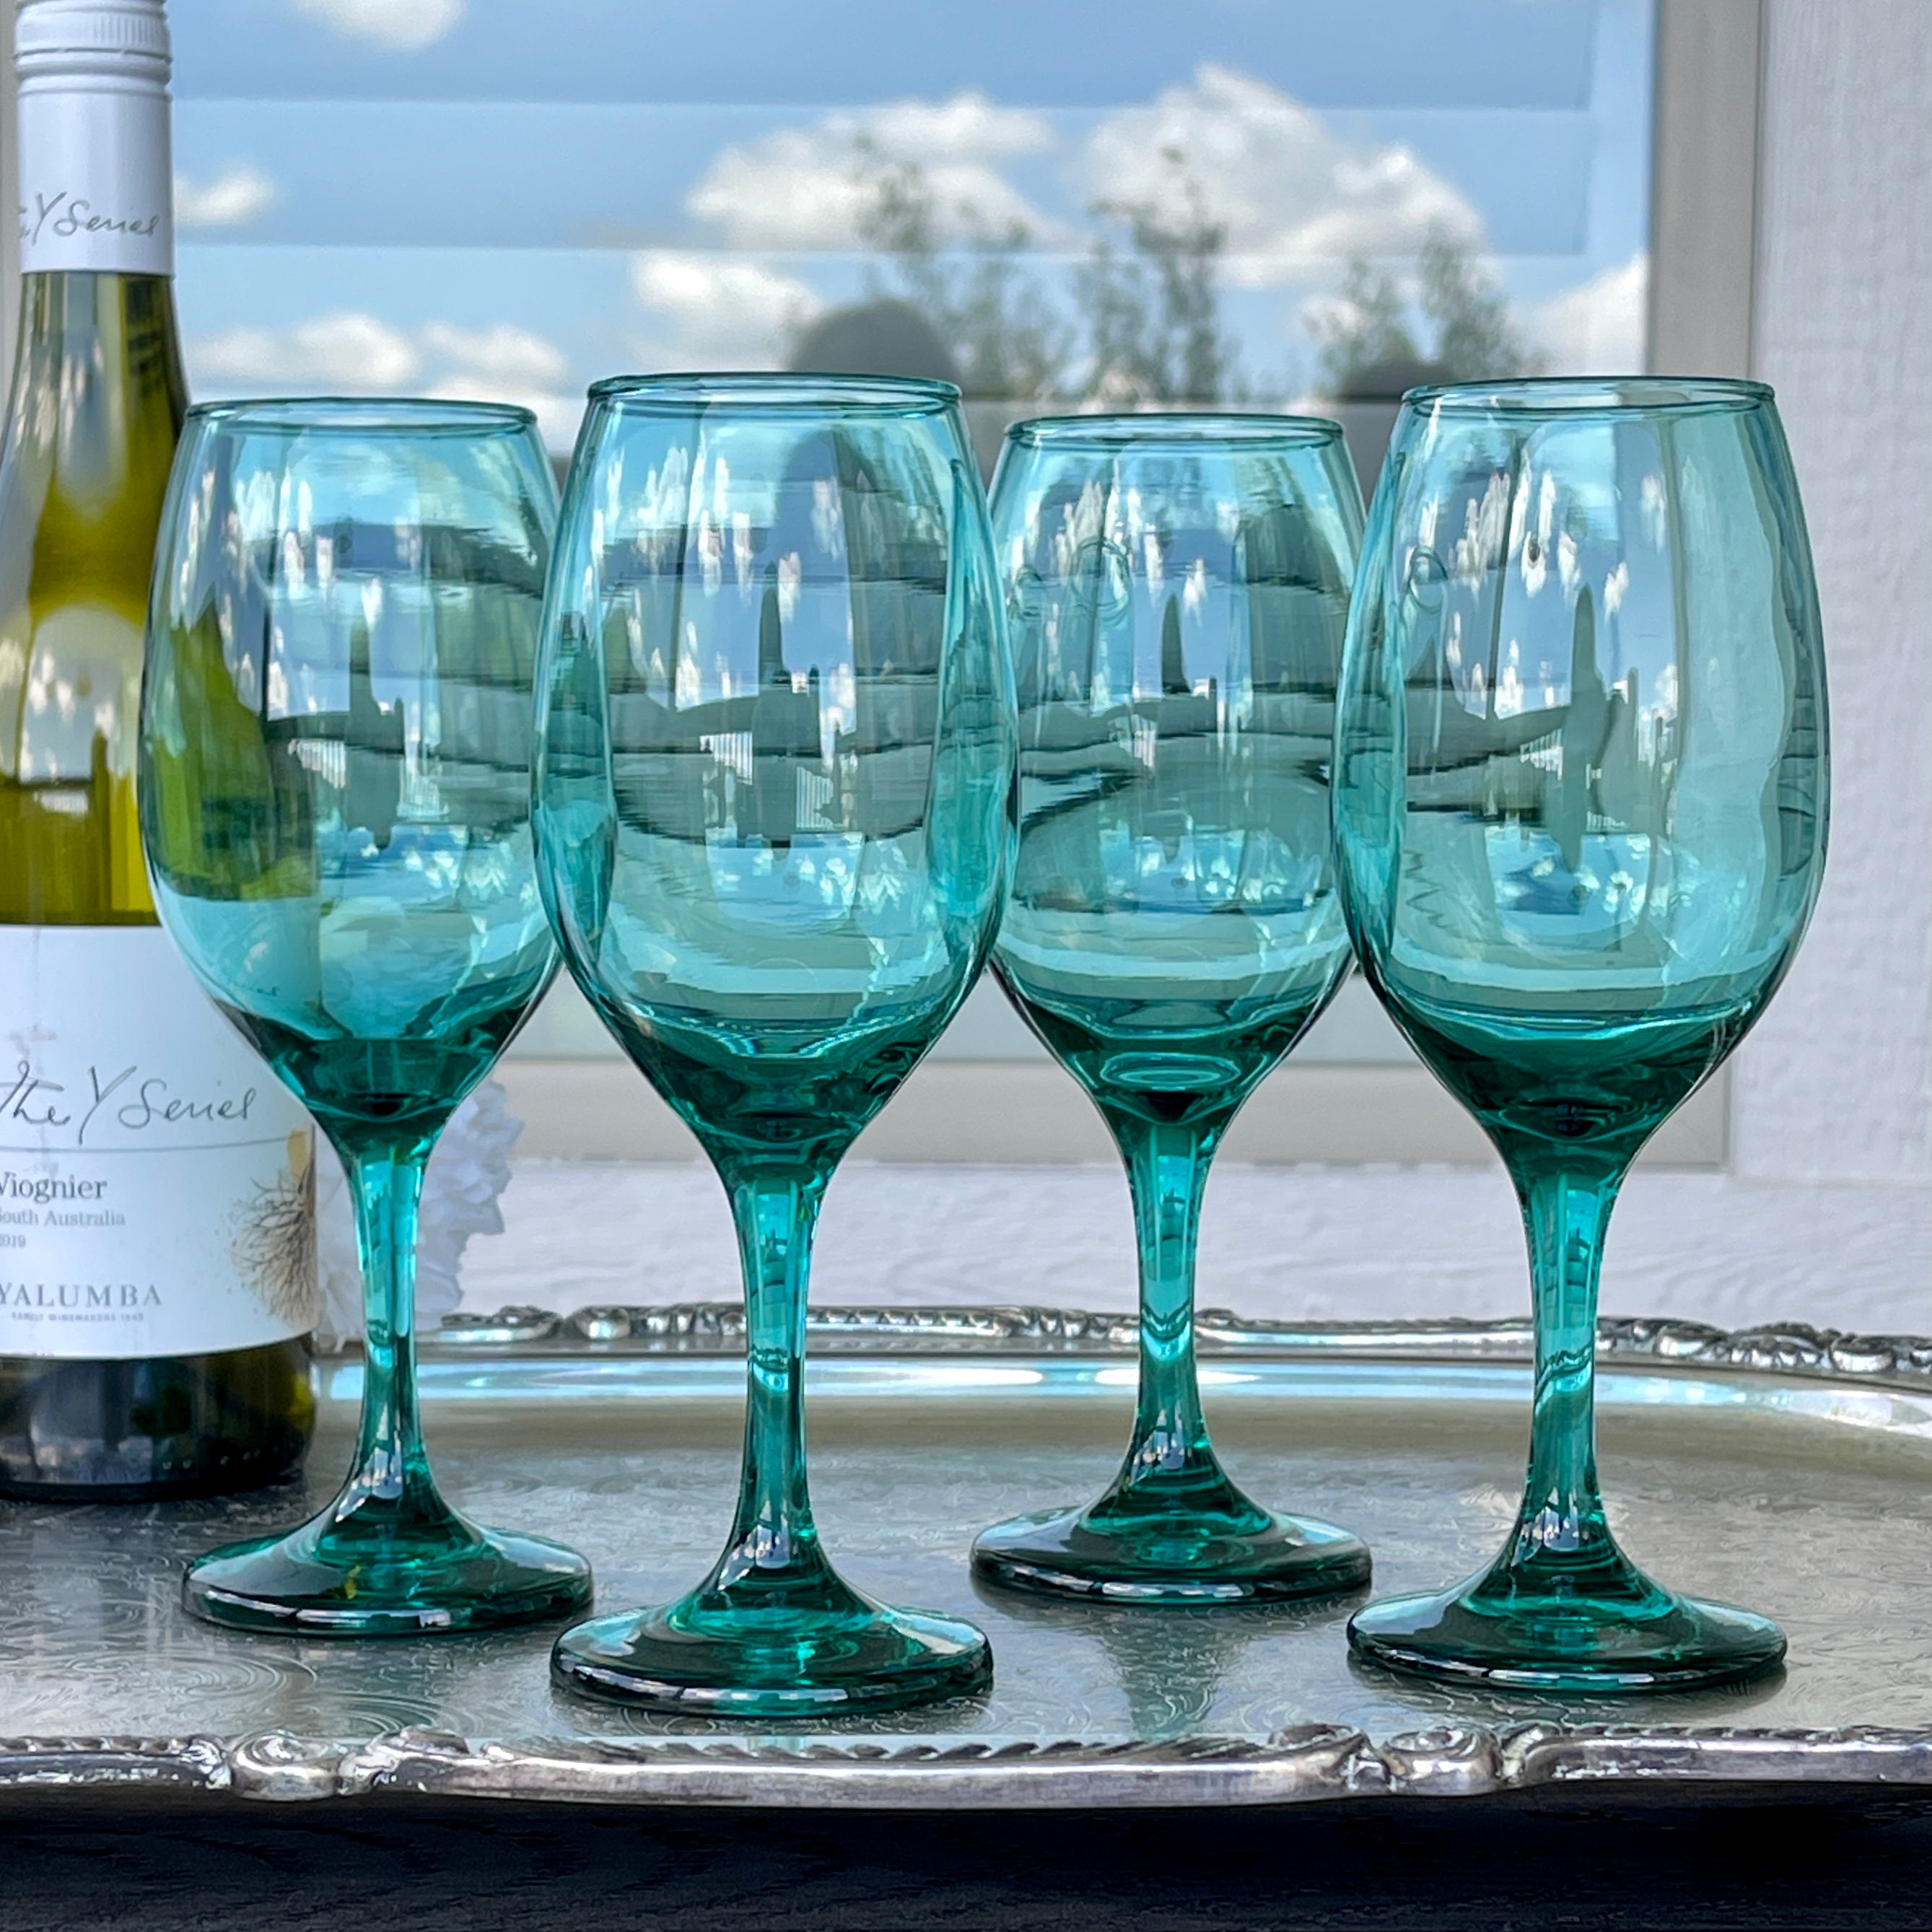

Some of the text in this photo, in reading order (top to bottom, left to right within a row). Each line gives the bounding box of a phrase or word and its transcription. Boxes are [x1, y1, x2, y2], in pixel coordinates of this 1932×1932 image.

[32, 191, 67, 246] Y
[77, 1065, 137, 1145] Y
[44, 1210, 126, 1226] Australia
[0, 1282, 162, 1307] YALUMBA
